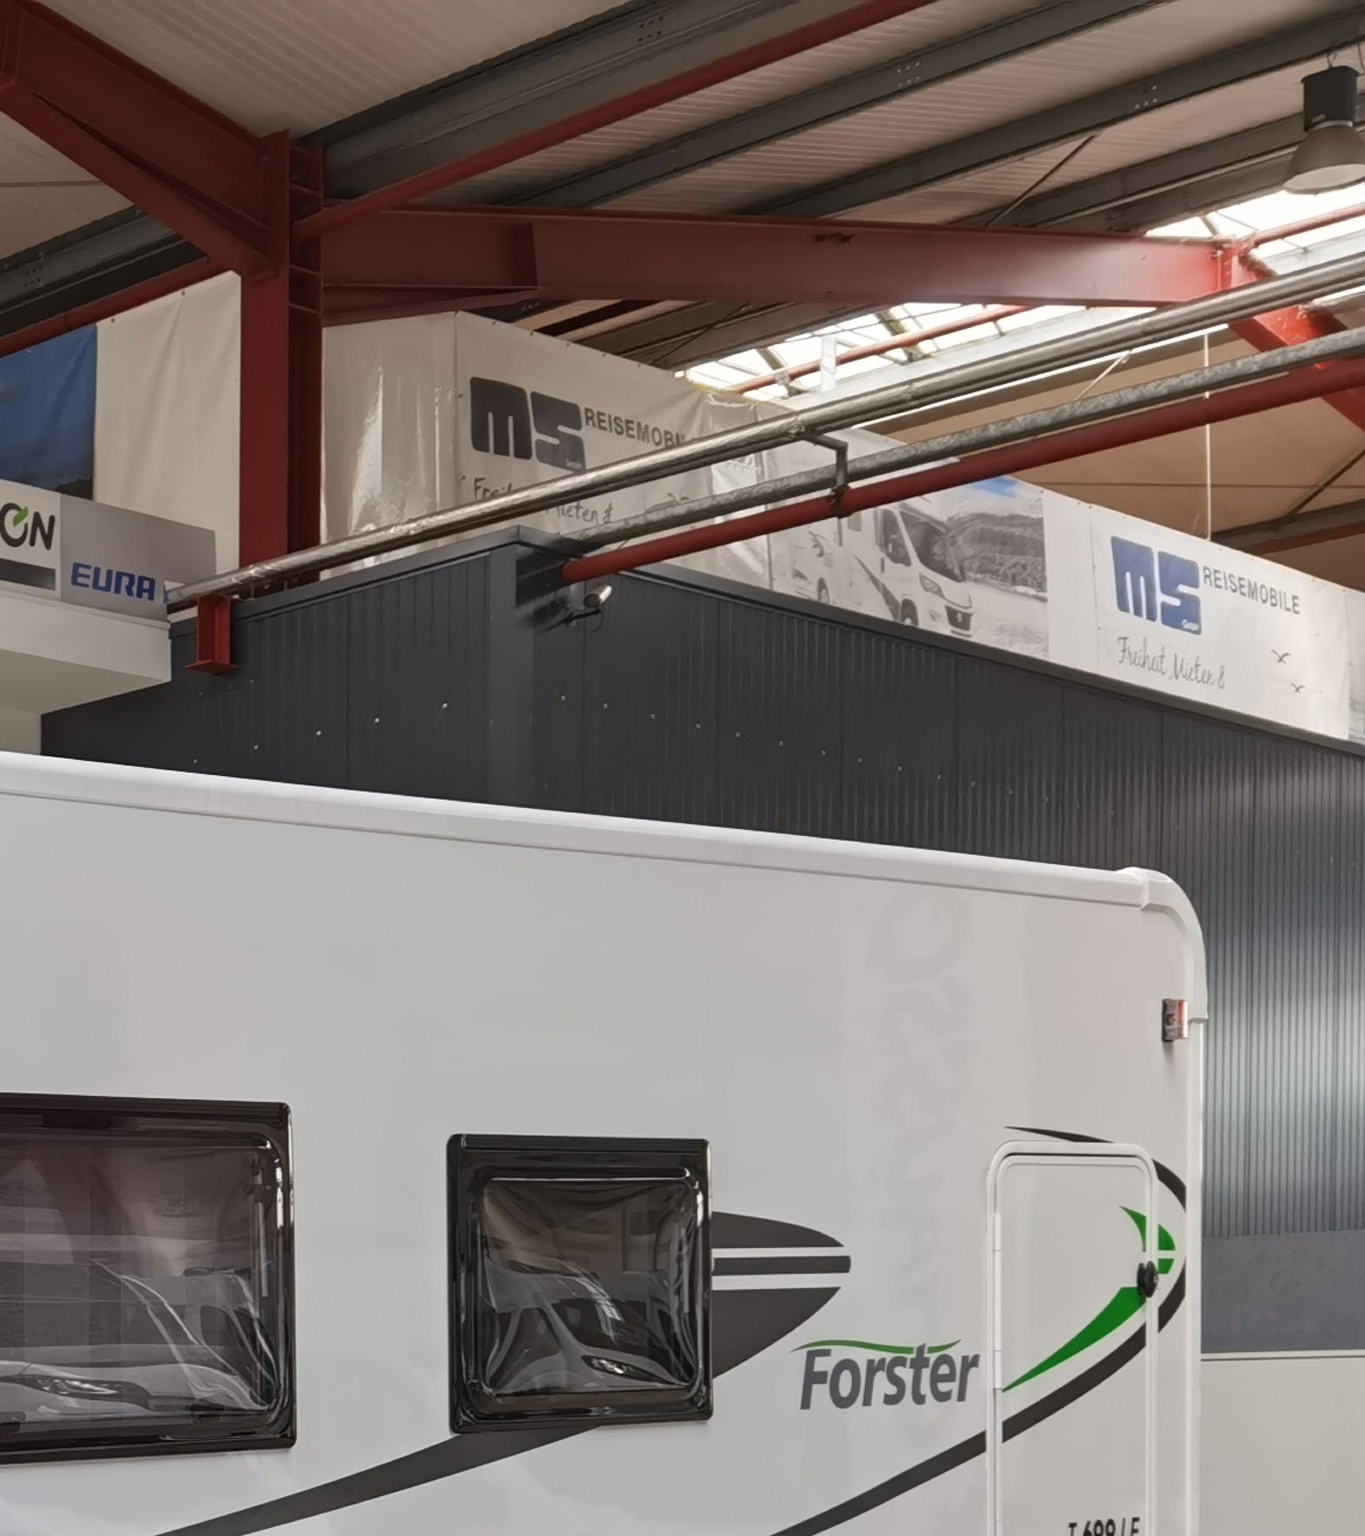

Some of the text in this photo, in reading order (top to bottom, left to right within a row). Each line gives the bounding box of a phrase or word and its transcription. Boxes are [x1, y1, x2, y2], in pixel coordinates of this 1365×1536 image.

[584, 407, 687, 449] REISEMOBI
[70, 562, 156, 601] EURA
[1203, 566, 1301, 615] REISEMOBILE
[800, 1343, 980, 1410] Forster
